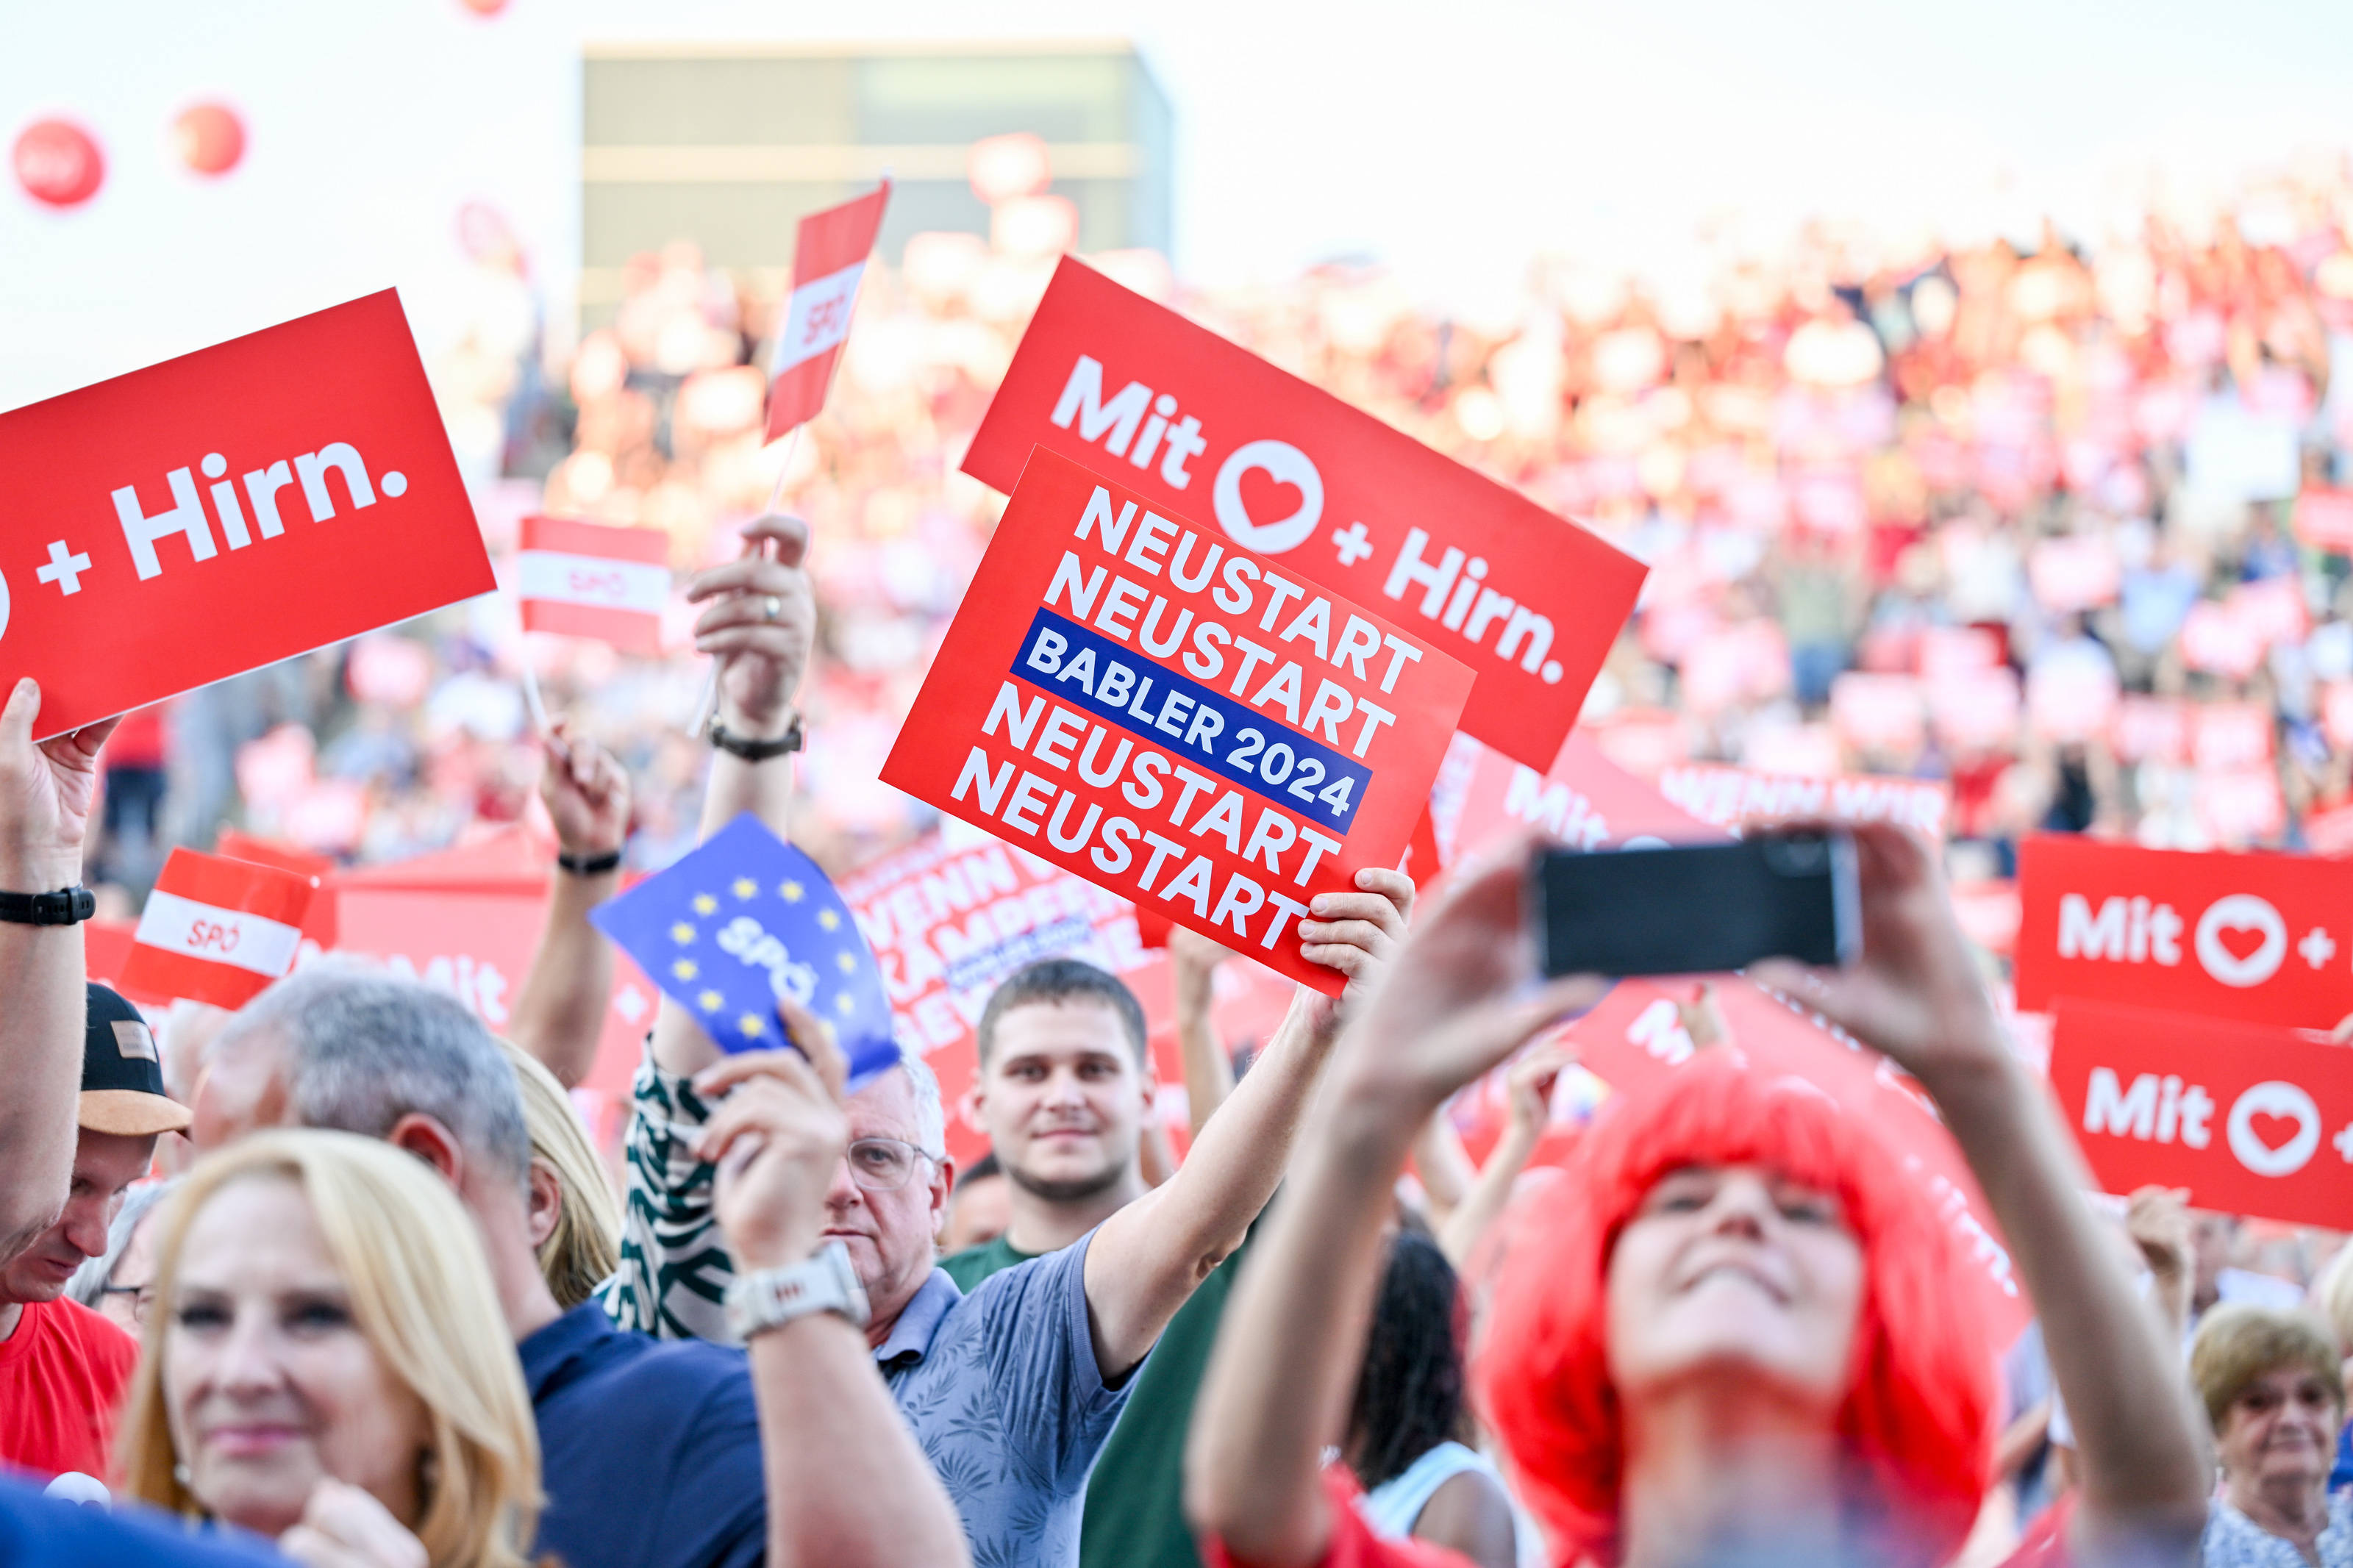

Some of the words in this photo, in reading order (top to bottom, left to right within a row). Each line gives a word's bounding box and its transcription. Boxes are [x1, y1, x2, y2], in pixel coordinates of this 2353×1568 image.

[110, 441, 408, 582] Hirn.
[1049, 354, 1208, 490] Mit
[1383, 526, 1565, 685] Hirn.
[1074, 484, 1423, 695] NEUSTART
[1026, 626, 1226, 753] BABLER
[1234, 730, 1352, 817] 2024
[1043, 549, 1396, 759] NEUSTART
[950, 745, 1310, 951] NEUSTART
[980, 680, 1343, 889] NEUSTART
[2057, 891, 2185, 968] Mit
[2082, 1064, 2215, 1150] Mit
